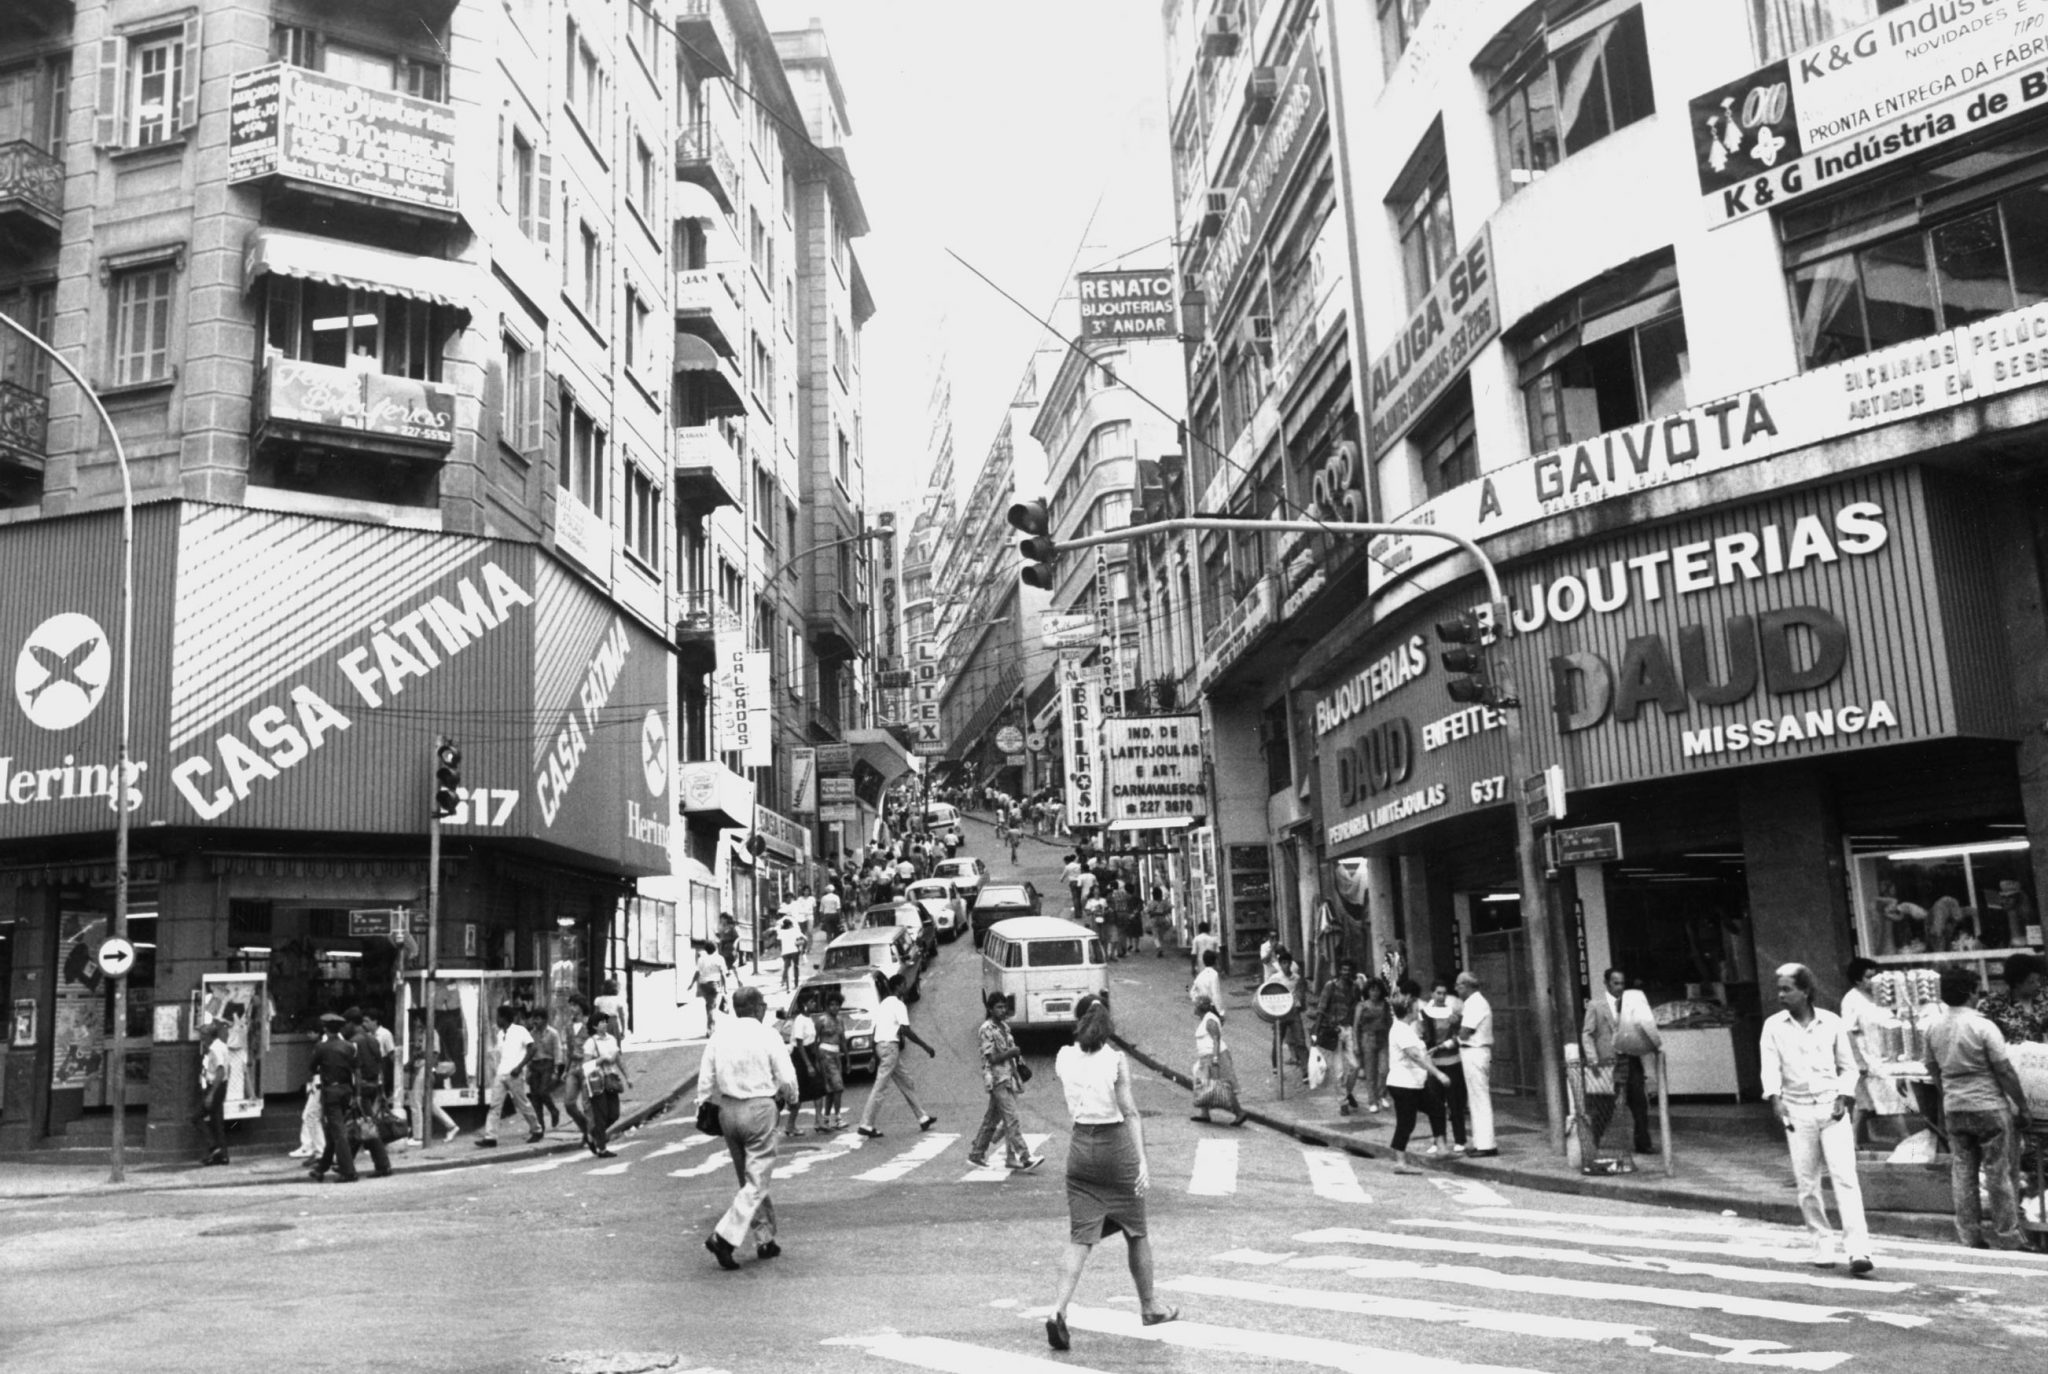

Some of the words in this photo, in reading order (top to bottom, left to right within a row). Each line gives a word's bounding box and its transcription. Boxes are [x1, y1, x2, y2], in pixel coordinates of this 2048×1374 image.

[1905, 8, 2008, 59] NOVIDADES
[2014, 13, 2045, 37] TIPO
[1808, 109, 1870, 144] PRONTA
[1875, 75, 1957, 118] ENTREGA
[1961, 61, 1989, 84] DA
[1815, 113, 1956, 180] Indústria
[1967, 92, 2008, 123] de
[2020, 67, 2048, 103] B
[1081, 277, 1172, 299] RENATO
[1082, 300, 1173, 316] BIJOUTERIAS
[1113, 317, 1166, 333] ANDAR
[1372, 296, 1445, 412] ALUGA
[1450, 236, 1487, 316] SE
[1478, 477, 1502, 524] A
[1533, 393, 1778, 503] GAIVOTA
[171, 684, 352, 820] CASA
[337, 561, 535, 708] FÁTIMA
[919, 644, 940, 741] LOTEX
[1102, 646, 1113, 697] PORTO
[1316, 634, 1427, 736] BIJOUTERIAS
[1549, 604, 1848, 736] DAUD
[537, 712, 587, 828] CASA
[580, 615, 631, 736] FÁTIMA
[1128, 727, 1154, 740] IND.
[1160, 726, 1178, 739] DE
[1682, 699, 1898, 758] MISSANGA
[1110, 743, 1199, 760] LANTEJOULAS
[1136, 765, 1144, 778] E
[1153, 764, 1181, 778] ART.
[1337, 715, 1412, 808] DAUD
[1140, 800, 1160, 813] 227
[1471, 775, 1505, 804] 637
[1077, 811, 1098, 824] 121
[1575, 902, 1588, 986] ATACADO
